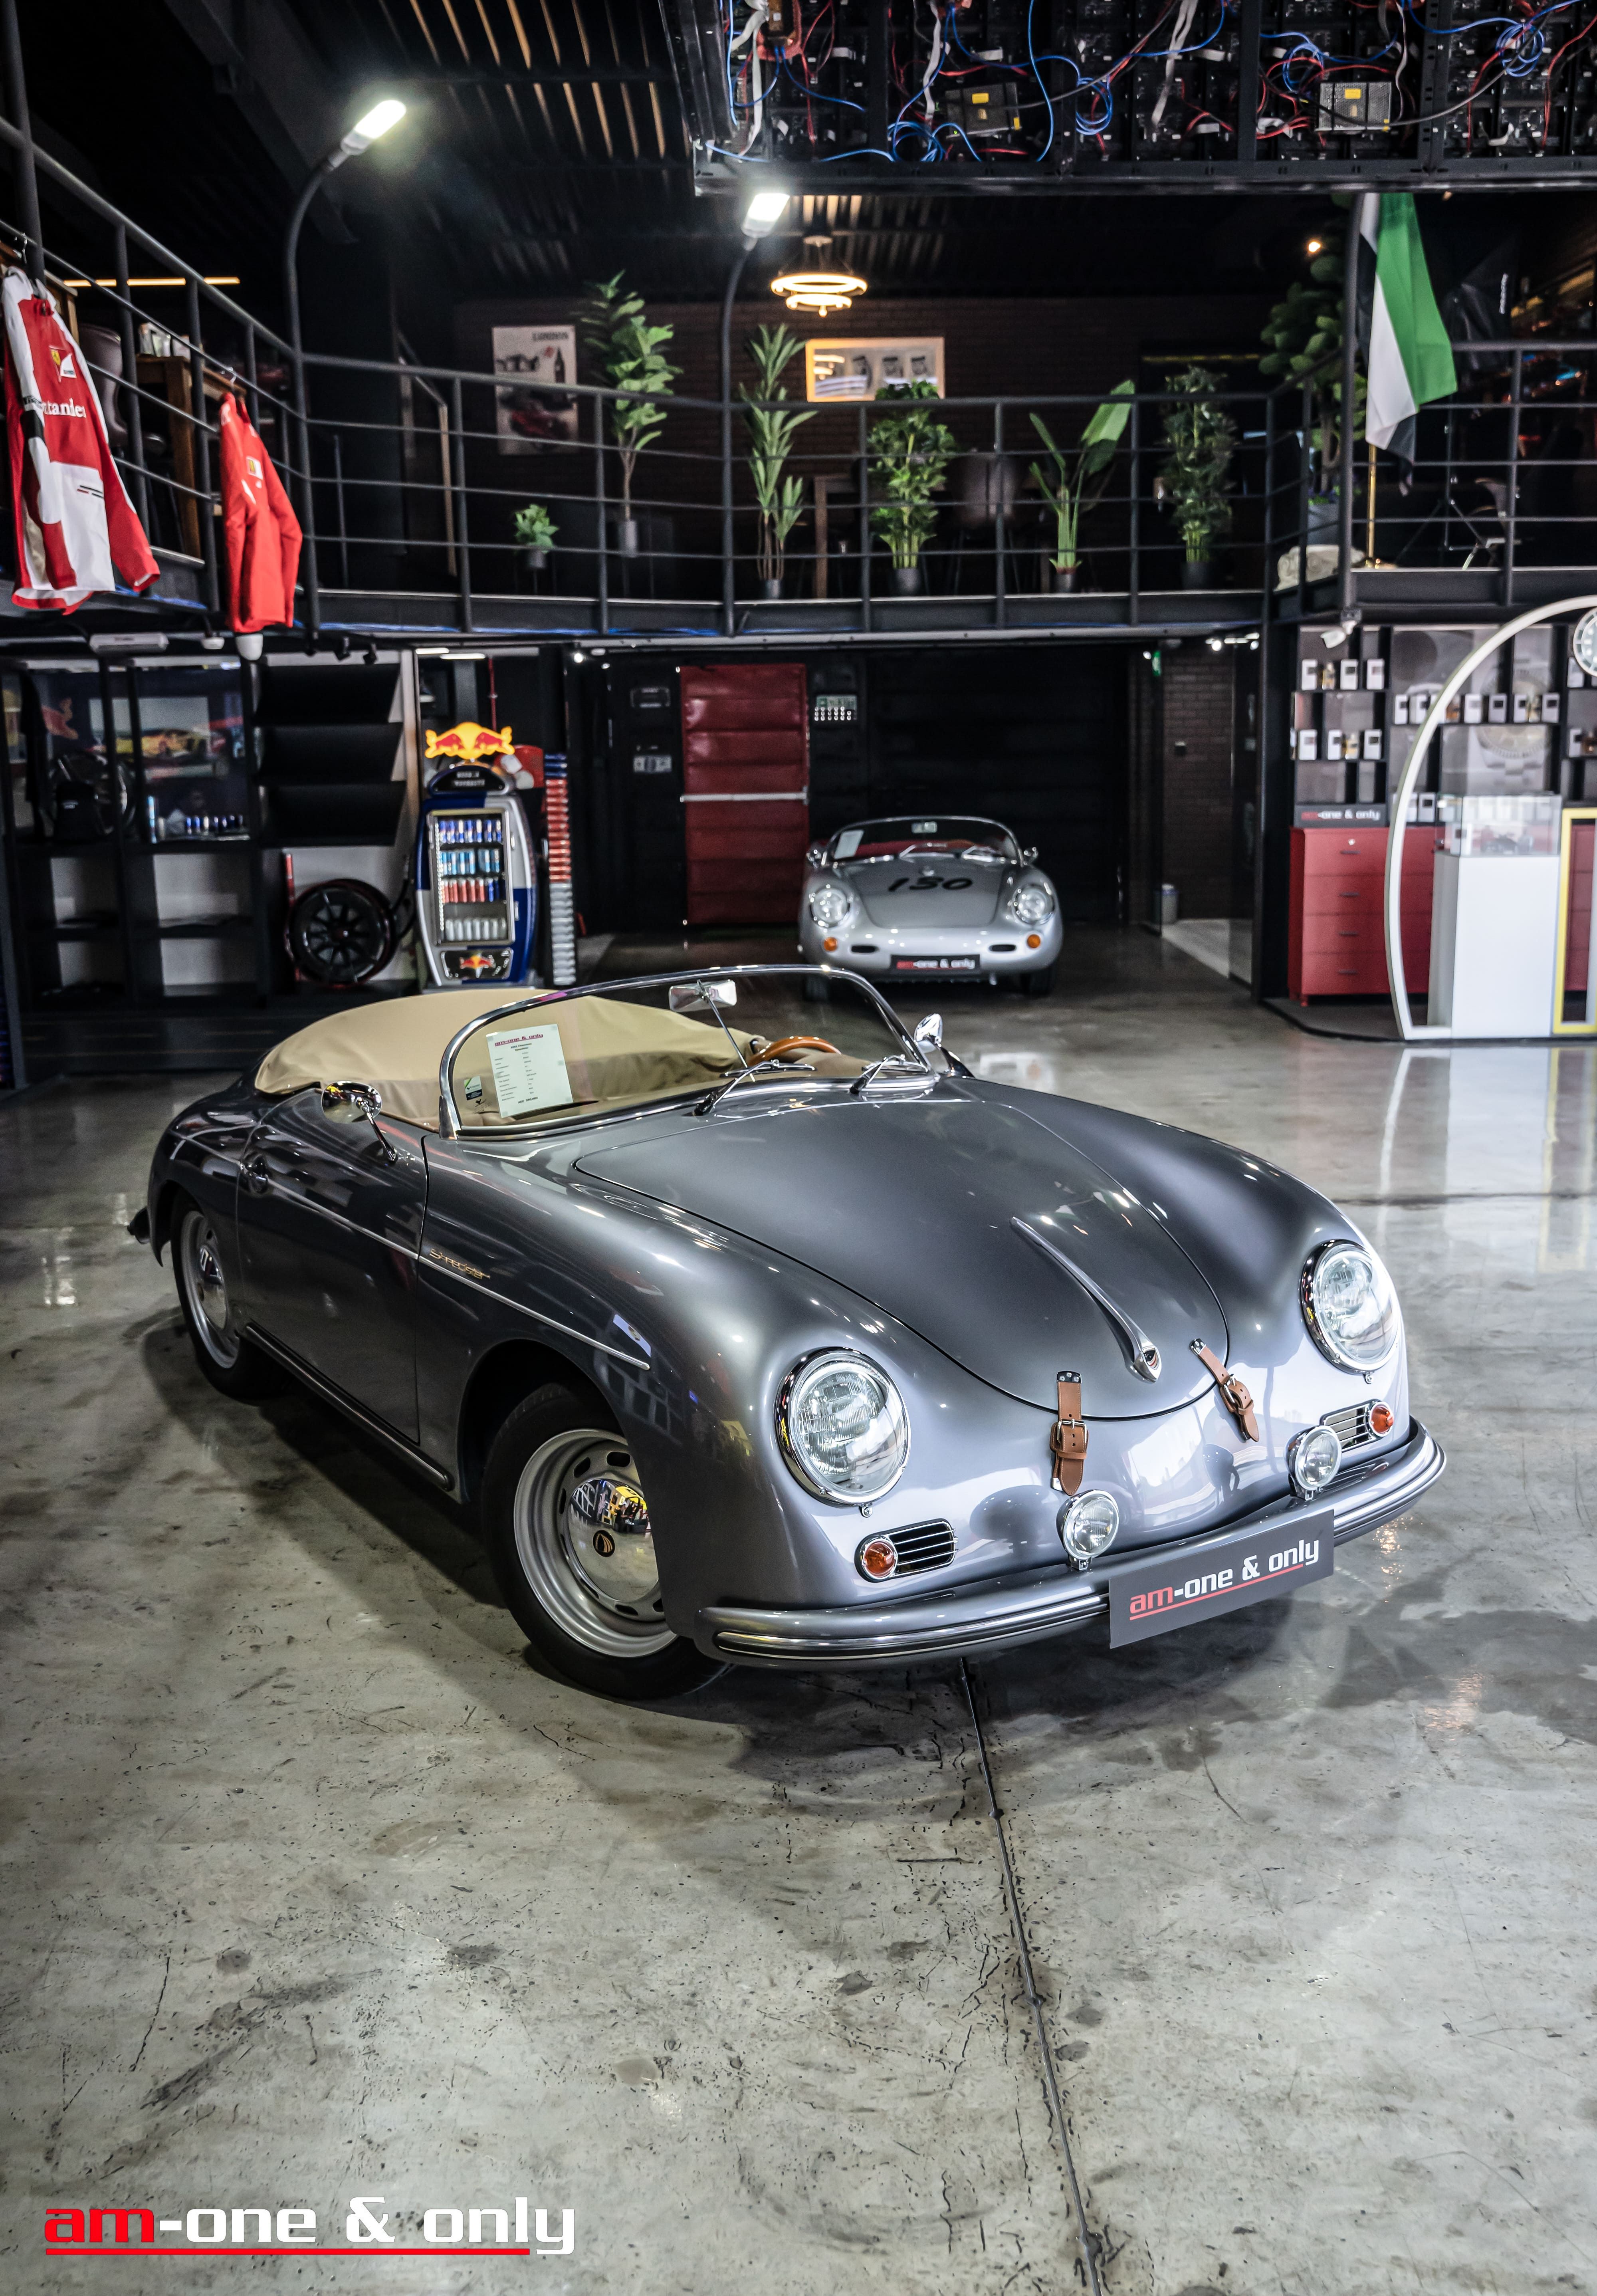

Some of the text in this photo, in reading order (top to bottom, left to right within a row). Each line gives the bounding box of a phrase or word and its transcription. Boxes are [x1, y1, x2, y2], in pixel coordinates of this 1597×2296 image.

[1344, 809, 1353, 819] &
[1355, 809, 1381, 821] only
[888, 876, 973, 892] 130
[939, 958, 950, 969] &
[951, 958, 976, 970] only
[429, 1248, 491, 1280] Speedster
[1129, 1539, 1319, 1614] am-one & only
